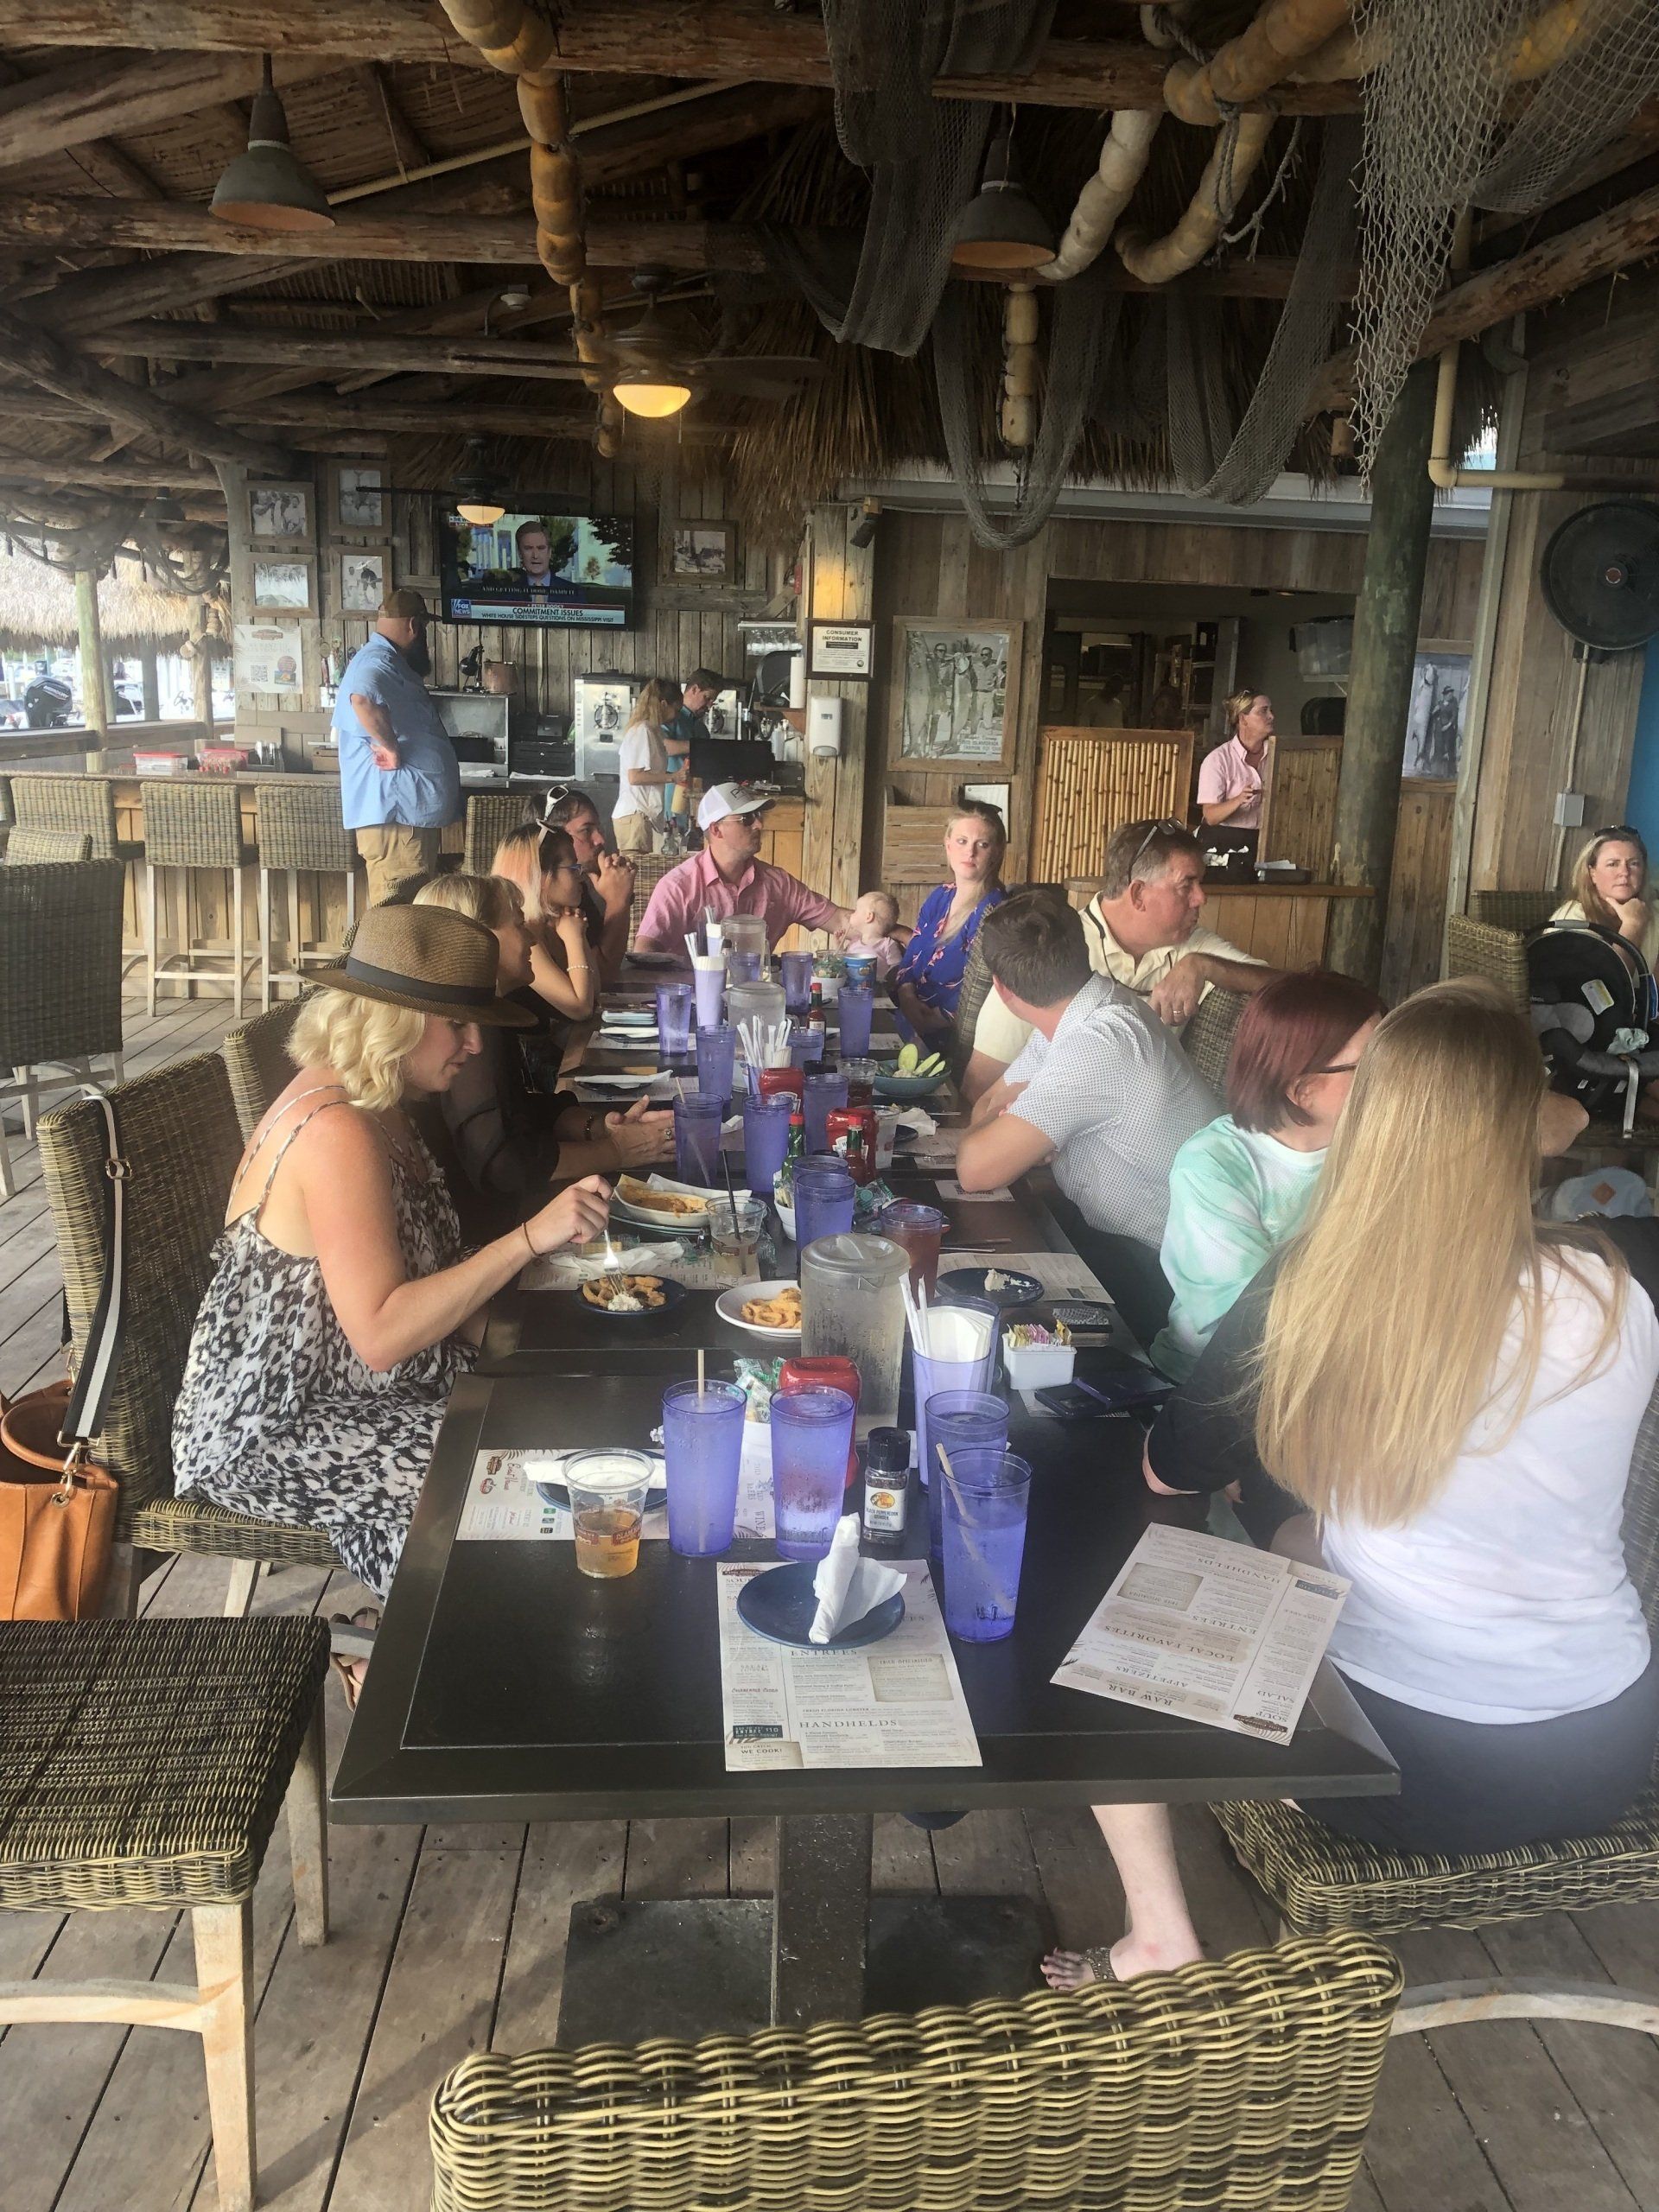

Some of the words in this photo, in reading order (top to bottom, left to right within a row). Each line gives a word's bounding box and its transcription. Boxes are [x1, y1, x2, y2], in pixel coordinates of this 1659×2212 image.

[512, 607, 558, 616] COMMITMENT
[754, 1510, 766, 1531] WINE
[1196, 1556, 1281, 1584] HANDHELDS
[1191, 1614, 1256, 1636] ENTREES
[1102, 1624, 1182, 1649] FAVORITES
[1184, 1644, 1235, 1662] LOCAL
[1114, 1663, 1189, 1689] APPETIZERS
[1104, 1682, 1136, 1697] BAR
[1256, 1688, 1295, 1704] SALAD
[1139, 1692, 1173, 1707] RAW
[798, 1719, 898, 1728] HANDHELDS
[1255, 1709, 1288, 1723] SOUP
